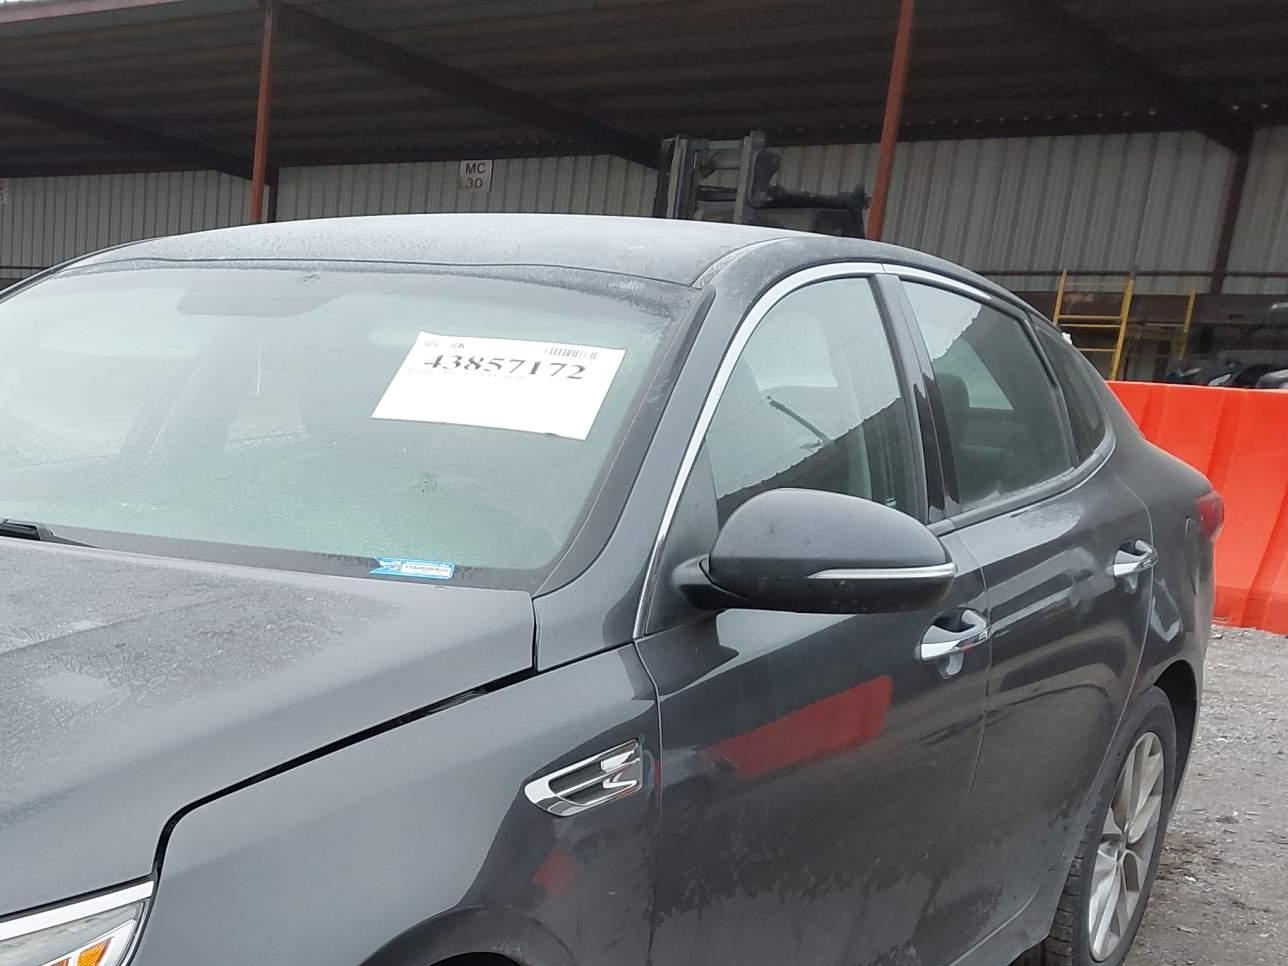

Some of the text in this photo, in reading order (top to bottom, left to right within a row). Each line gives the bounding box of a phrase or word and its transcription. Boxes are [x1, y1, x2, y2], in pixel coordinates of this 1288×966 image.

[465, 162, 486, 175] MC
[465, 177, 484, 189] 30
[423, 353, 587, 381] 43857172
